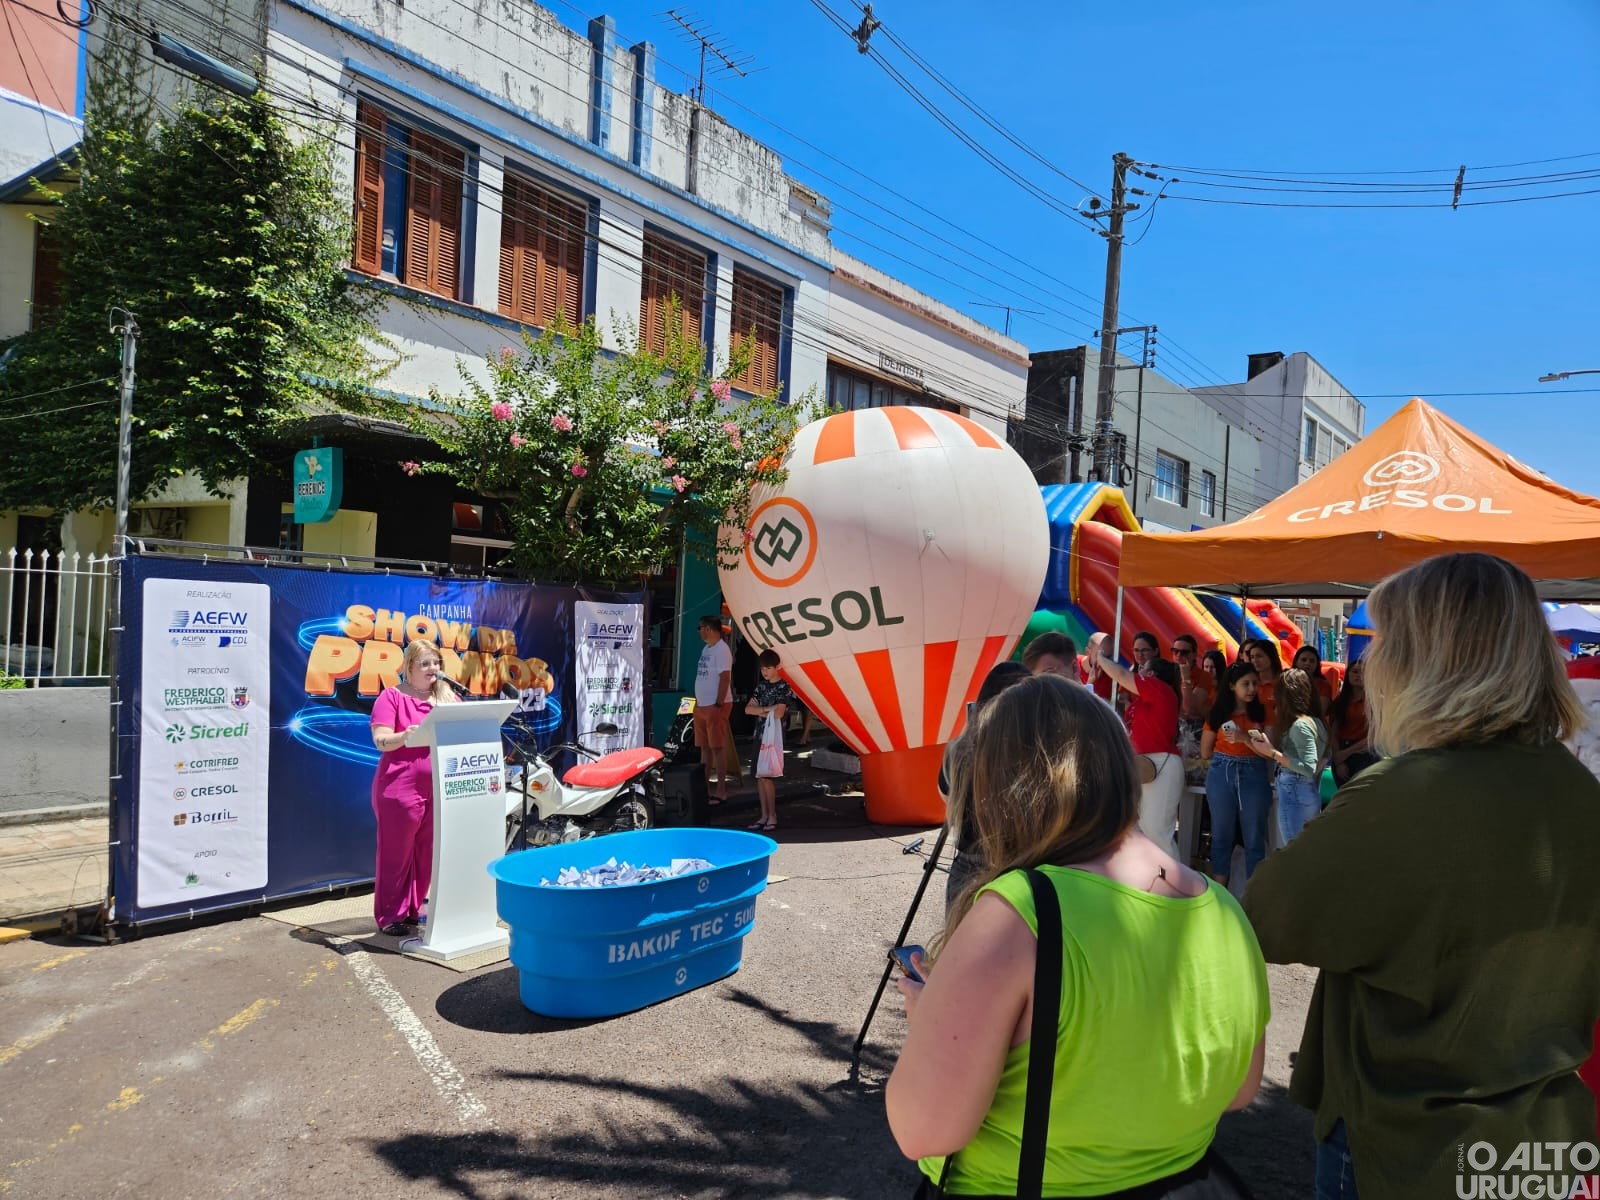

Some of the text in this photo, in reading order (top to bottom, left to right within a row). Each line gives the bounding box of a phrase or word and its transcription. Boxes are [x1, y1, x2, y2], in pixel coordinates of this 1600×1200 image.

[298, 482, 325, 496] BERENICE
[1287, 489, 1513, 523] CRESOL
[192, 610, 248, 625] AEFW
[419, 603, 473, 620] CAMPANHA
[742, 586, 905, 650] CRESOL
[343, 604, 518, 656] SHOW DE
[599, 624, 633, 634] AEFW
[232, 636, 248, 644] CDL
[305, 634, 555, 696] PRMIOS
[164, 687, 225, 697] FREDERICO
[165, 696, 225, 706] WESTPHALEN
[601, 703, 632, 714] Sicredi
[189, 722, 249, 740] Sicredi
[190, 757, 239, 768] COTRIFRED
[460, 753, 499, 768] AEFW
[444, 777, 485, 789] FREDERICO
[191, 784, 239, 797] CRESOL
[445, 785, 486, 796] WESTPHALEN
[194, 850, 218, 858] APOIO
[607, 929, 682, 963] BAKOF
[690, 917, 724, 942] TEC
